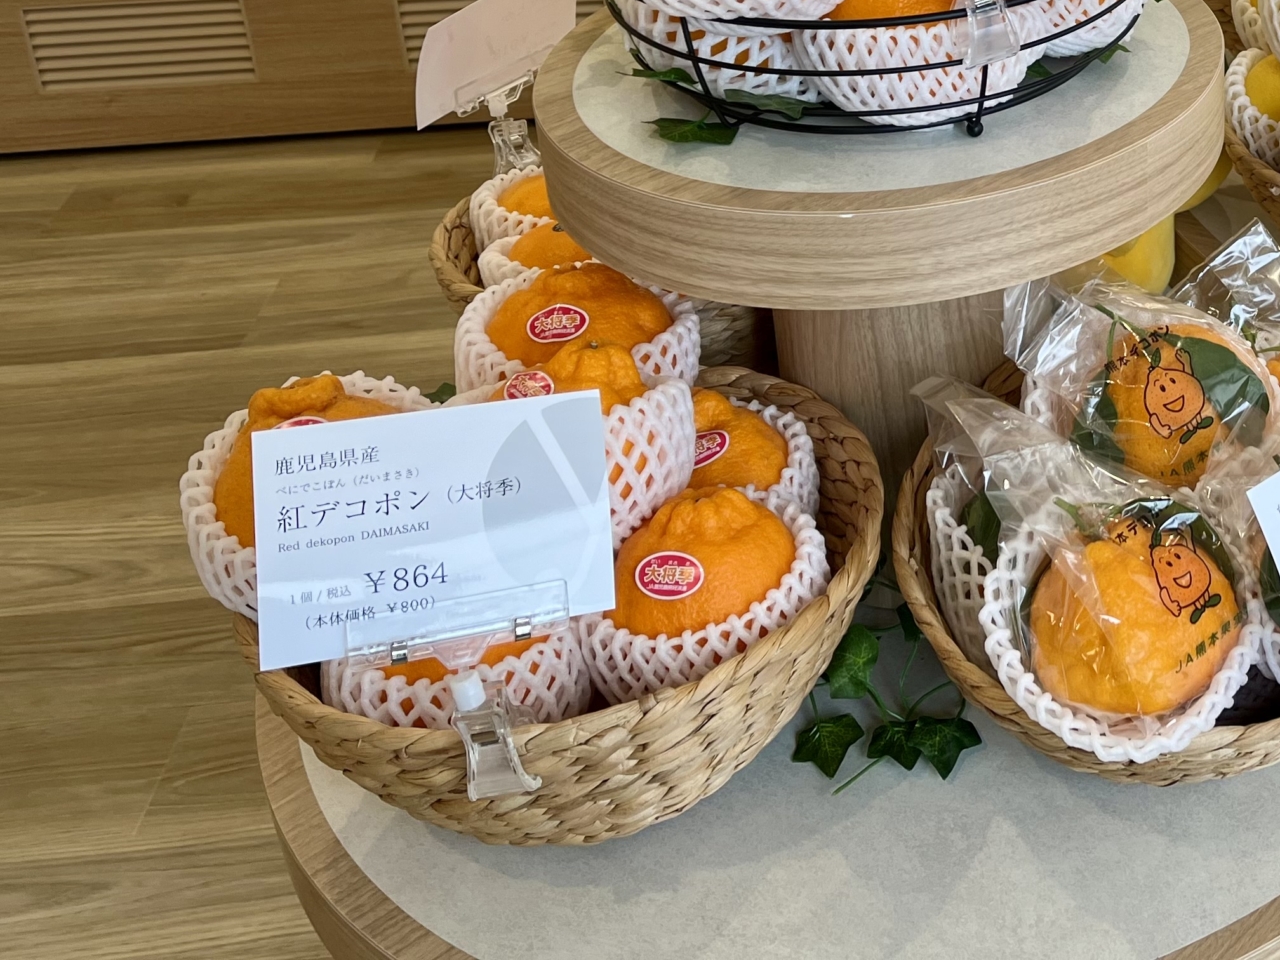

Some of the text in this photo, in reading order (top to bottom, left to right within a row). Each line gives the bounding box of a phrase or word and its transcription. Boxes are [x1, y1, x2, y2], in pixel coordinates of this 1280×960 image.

[535, 313, 580, 333] 大将季
[1104, 325, 1171, 374] 熊本デコポン
[275, 445, 381, 477] 鹿児島県産
[278, 521, 430, 553] Red dekopon DAIMASAKI
[364, 562, 448, 595] ¥864
[643, 564, 695, 584] 大将季
